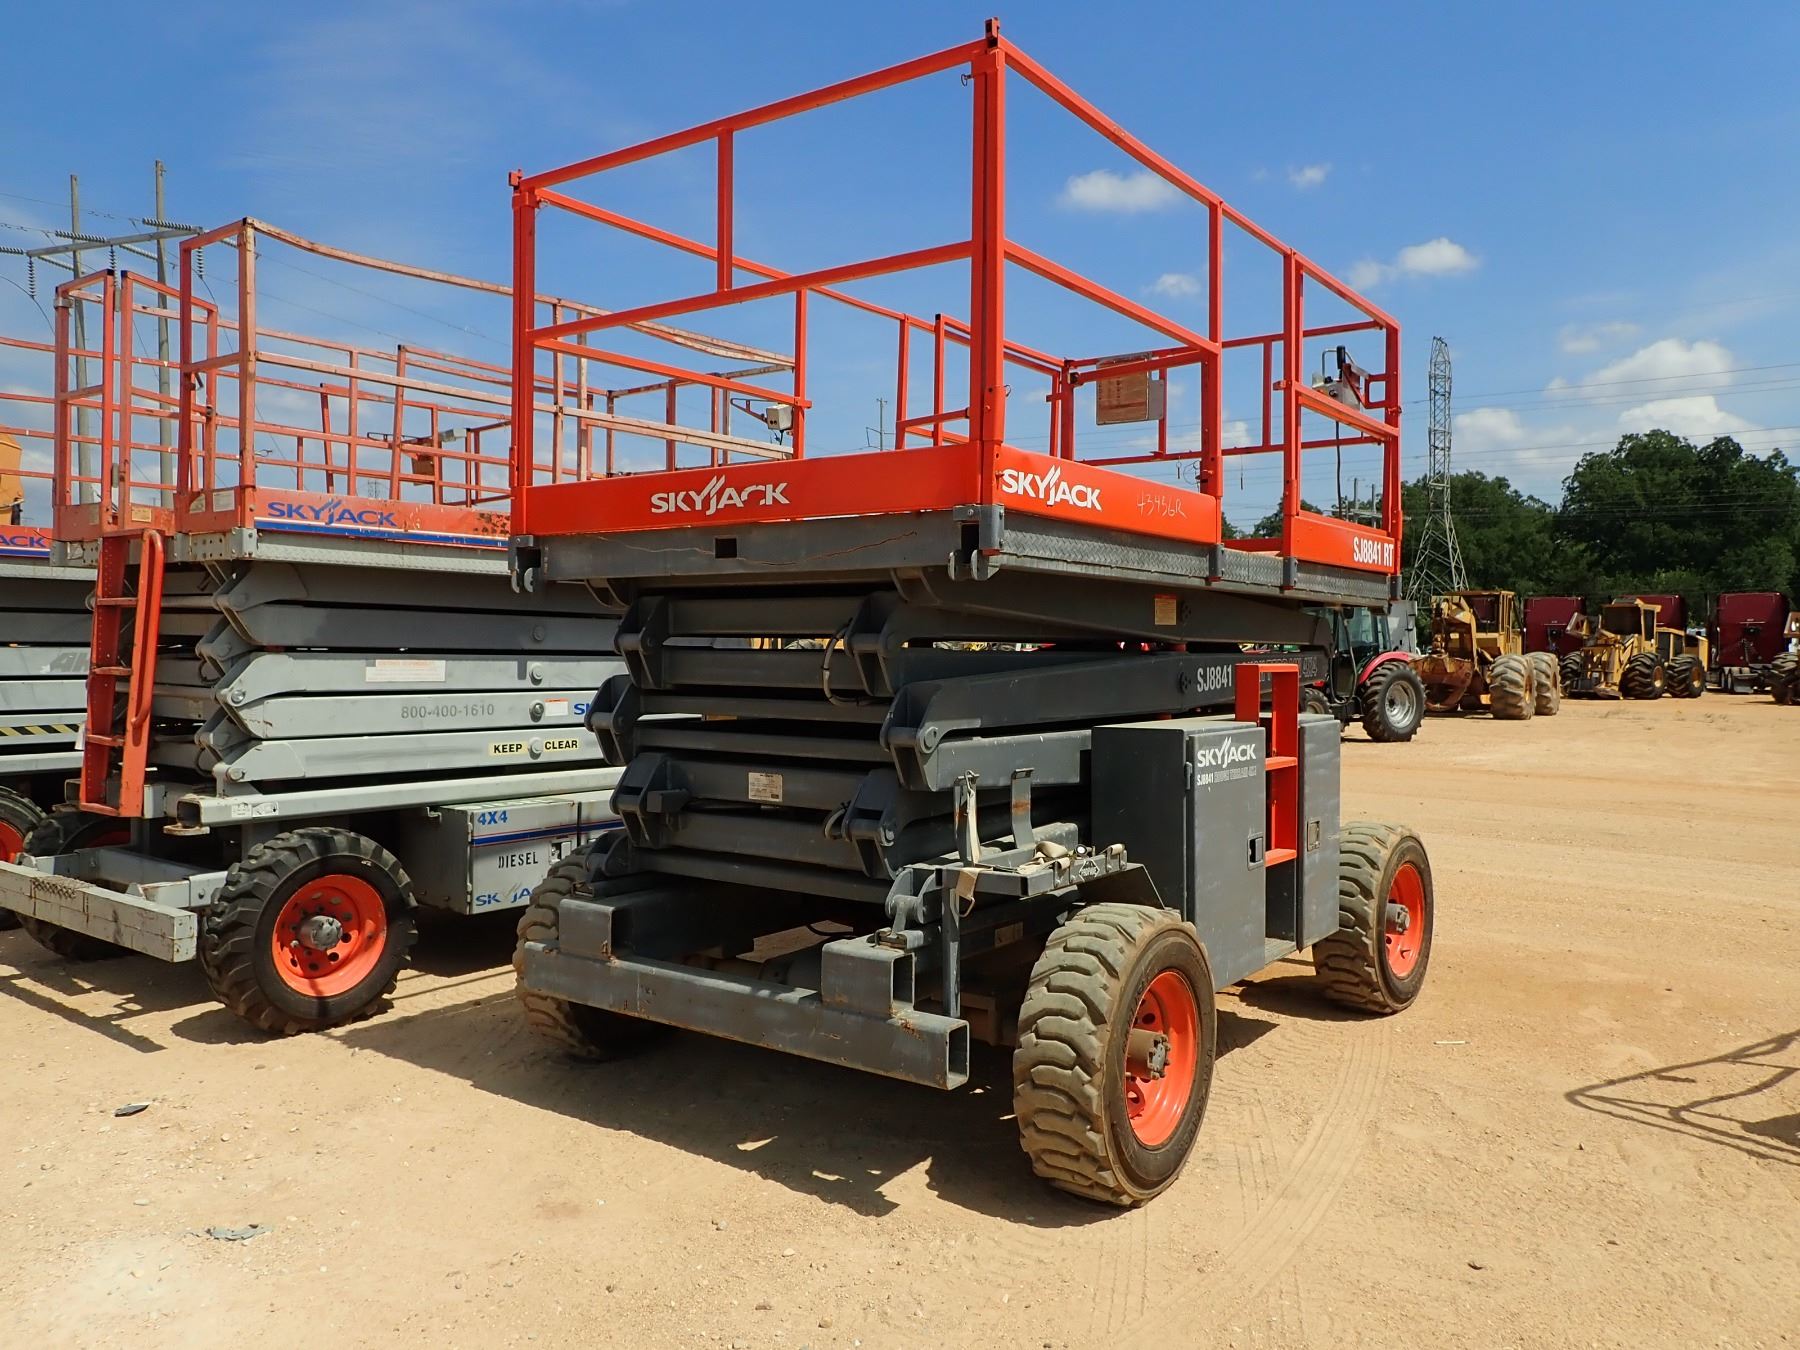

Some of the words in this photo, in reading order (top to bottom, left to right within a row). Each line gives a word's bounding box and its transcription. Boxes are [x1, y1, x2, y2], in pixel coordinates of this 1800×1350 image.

[651, 475, 791, 515] SKYJACK
[1002, 465, 1102, 511] SKYJACK
[268, 498, 397, 526] SKYJACK
[1353, 536, 1382, 566] SJ8841
[1383, 542, 1395, 567] RT
[1197, 664, 1232, 692] SJ8841
[401, 703, 495, 719] 800-400-1610
[493, 743, 523, 754] KEEP
[544, 740, 578, 750] CLEAR
[1197, 736, 1257, 768] SKYJACK
[477, 810, 508, 826] 4X4
[498, 852, 539, 869] DIESEL
